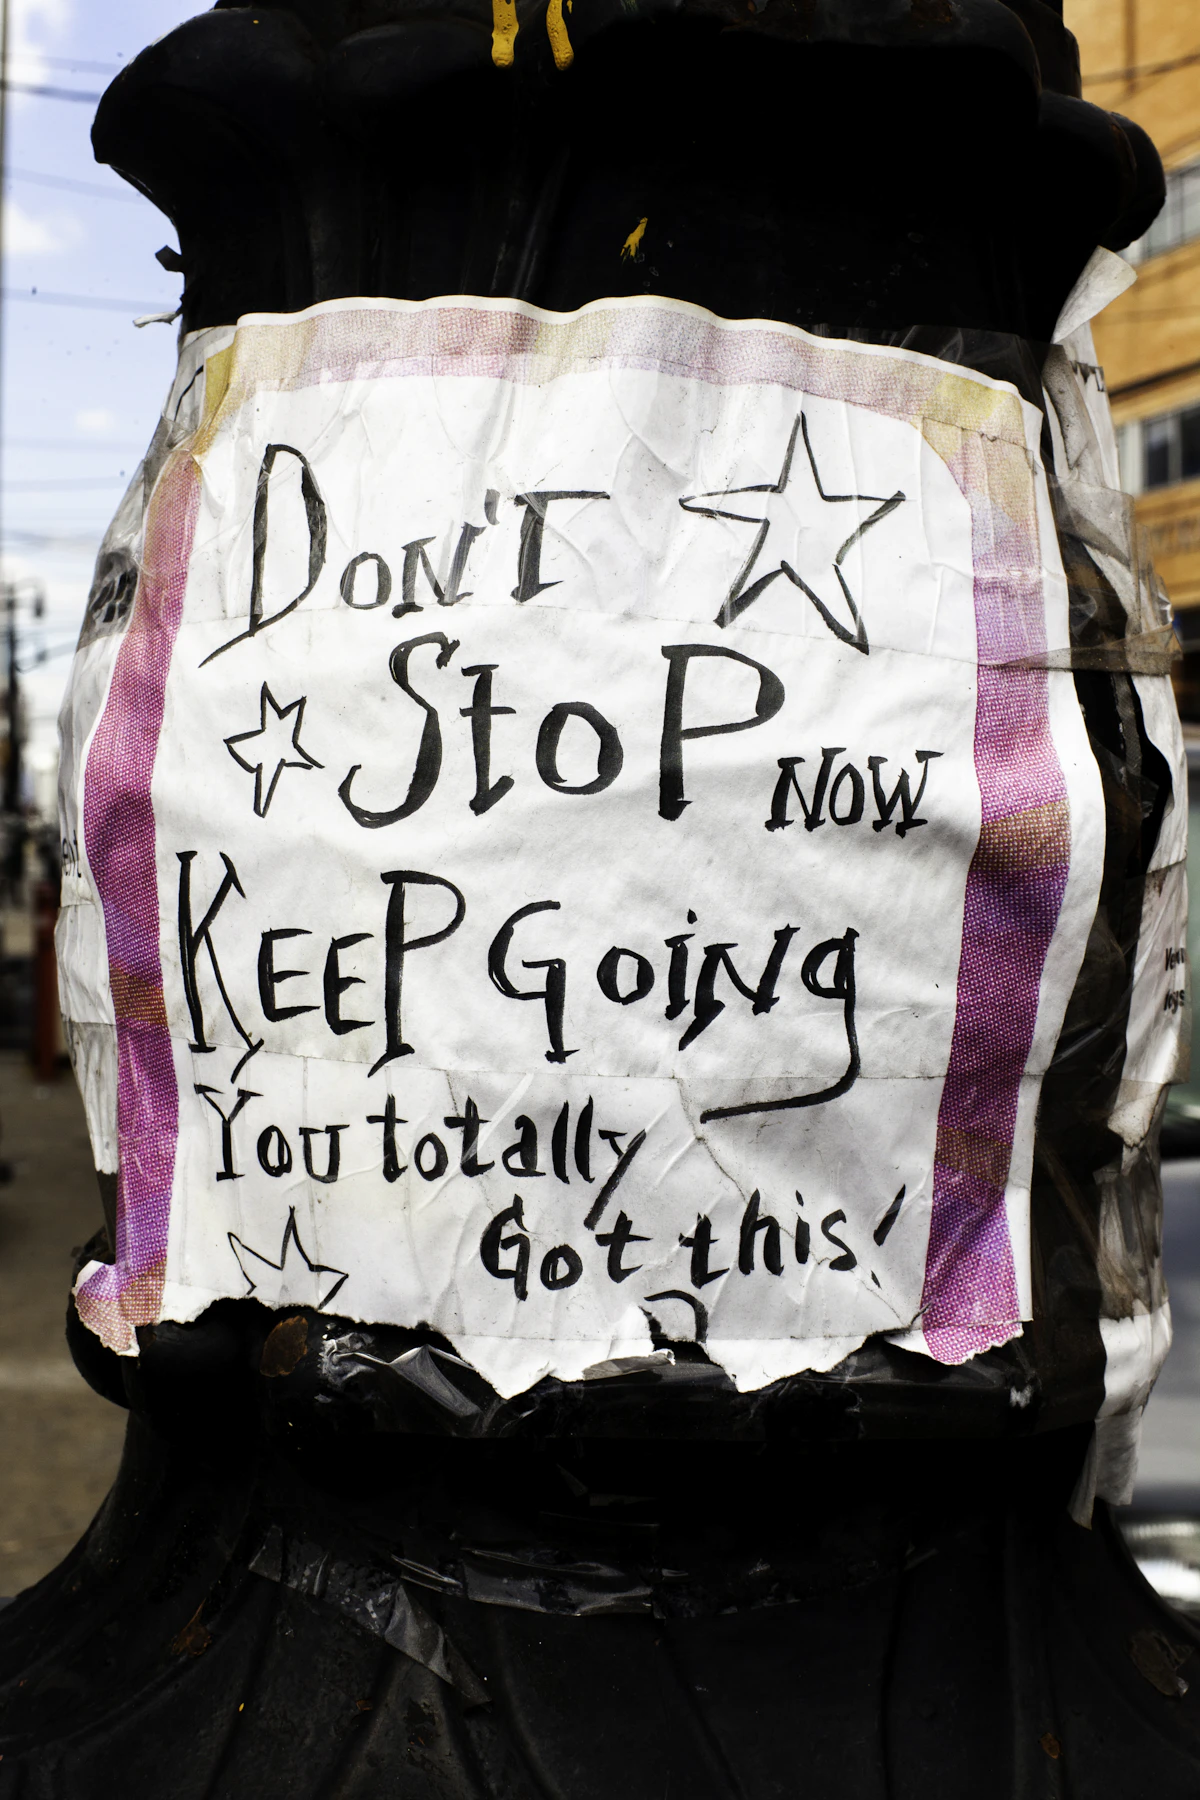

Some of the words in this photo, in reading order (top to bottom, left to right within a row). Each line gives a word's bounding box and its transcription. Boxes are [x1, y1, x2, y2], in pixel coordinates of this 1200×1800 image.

[366, 1093, 647, 1231] totally
[480, 1193, 652, 1302] Got
[678, 1183, 907, 1290] this!
